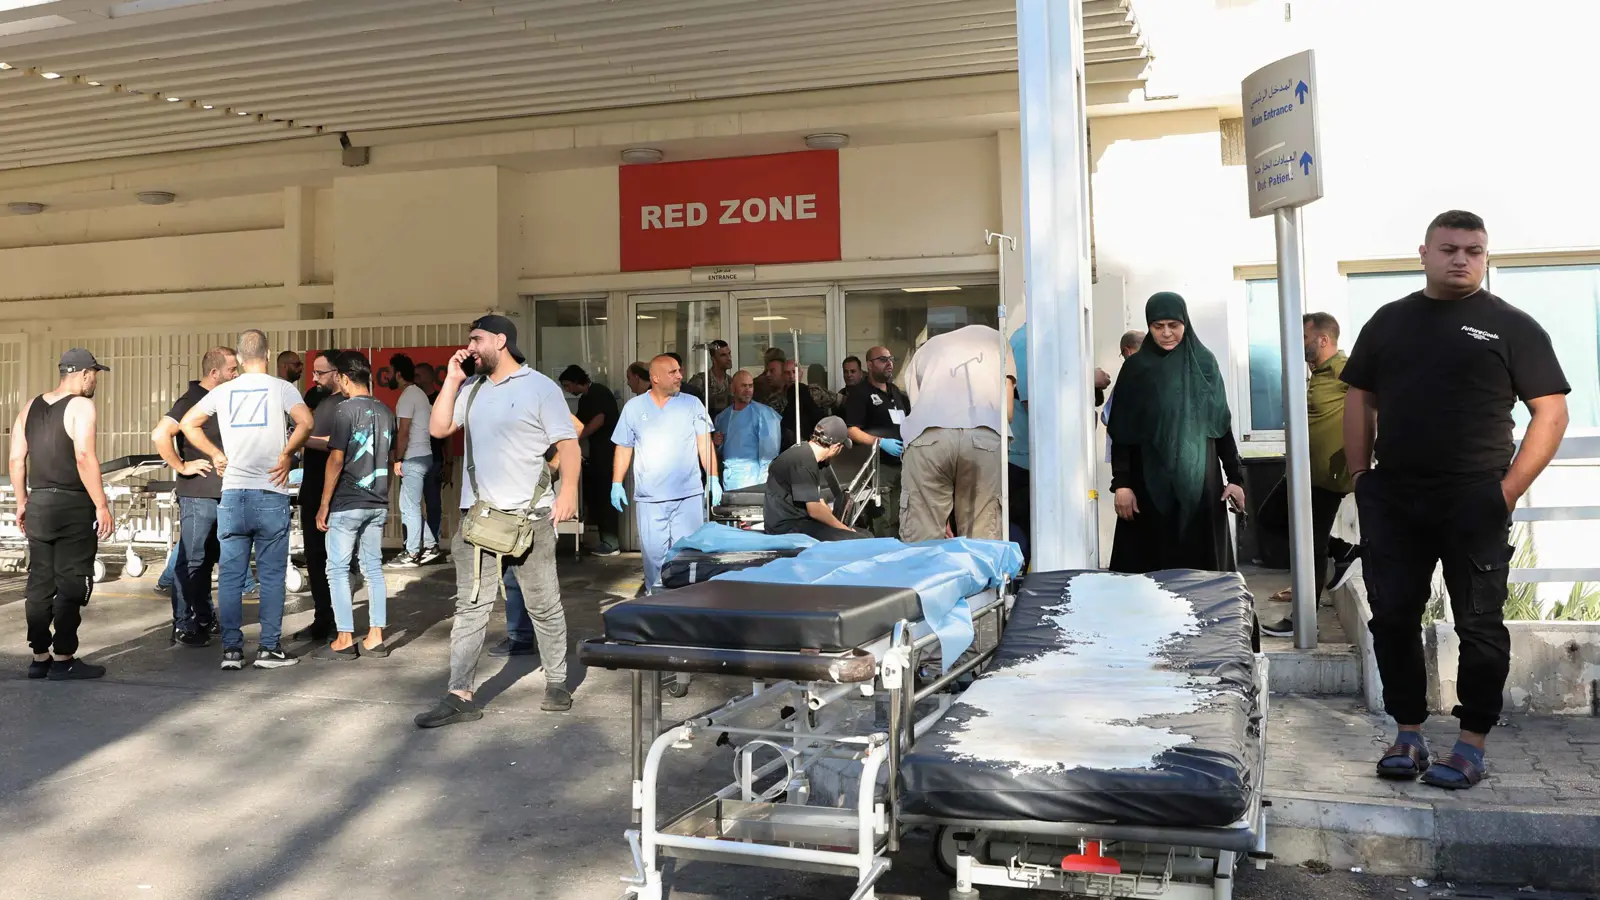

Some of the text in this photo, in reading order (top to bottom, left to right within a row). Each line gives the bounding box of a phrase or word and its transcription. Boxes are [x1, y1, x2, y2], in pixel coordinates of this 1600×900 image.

[1249, 79, 1292, 111] المدخل الرئيسي
[1251, 103, 1293, 128] Main Entrance
[1257, 179, 1267, 192] Out
[641, 194, 817, 230] RED ZONE
